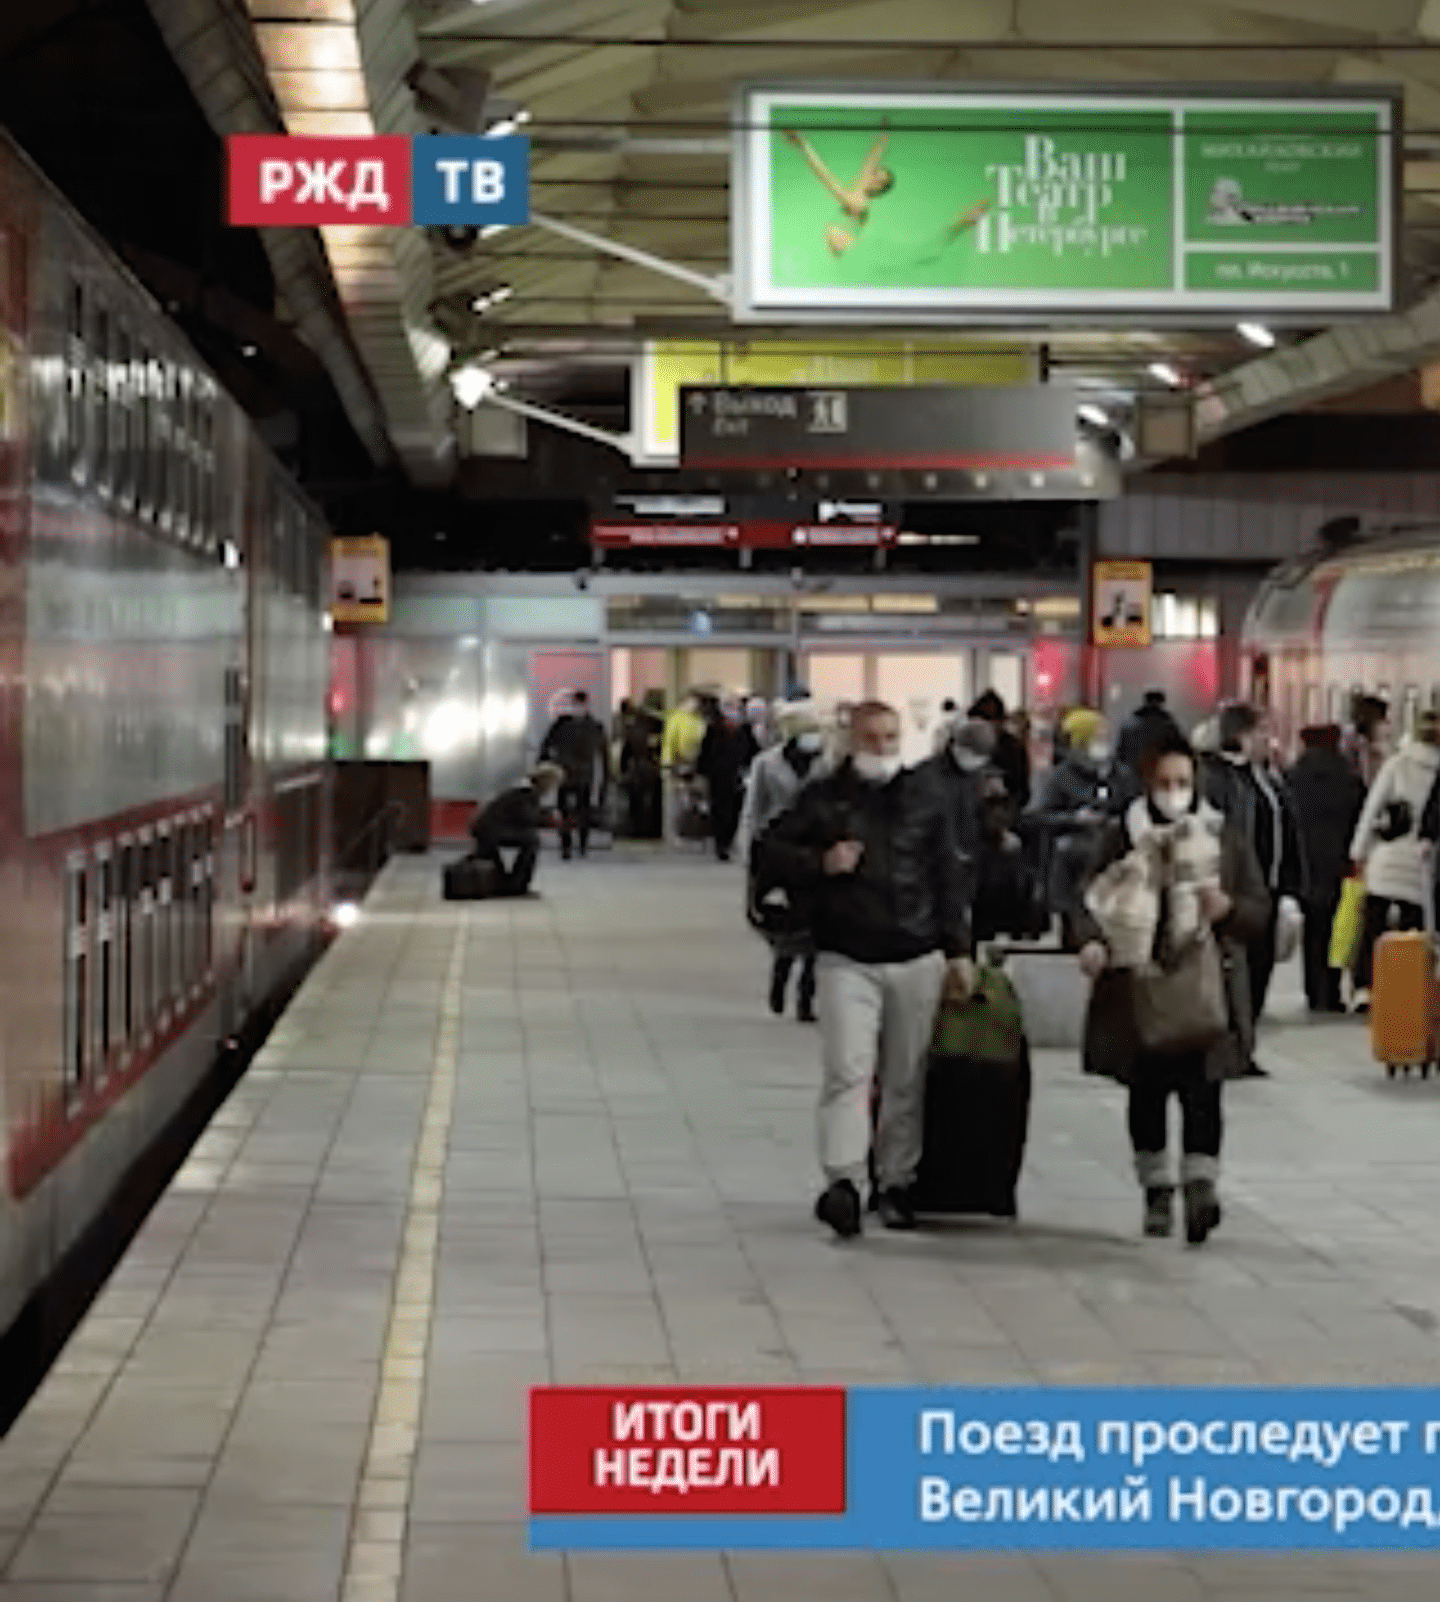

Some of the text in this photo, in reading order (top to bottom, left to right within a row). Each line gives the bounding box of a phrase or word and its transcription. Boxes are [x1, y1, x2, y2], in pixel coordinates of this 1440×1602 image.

[1024, 134, 1128, 182] Ваш
[984, 163, 1114, 225] Театр
[713, 391, 799, 420] Выход
